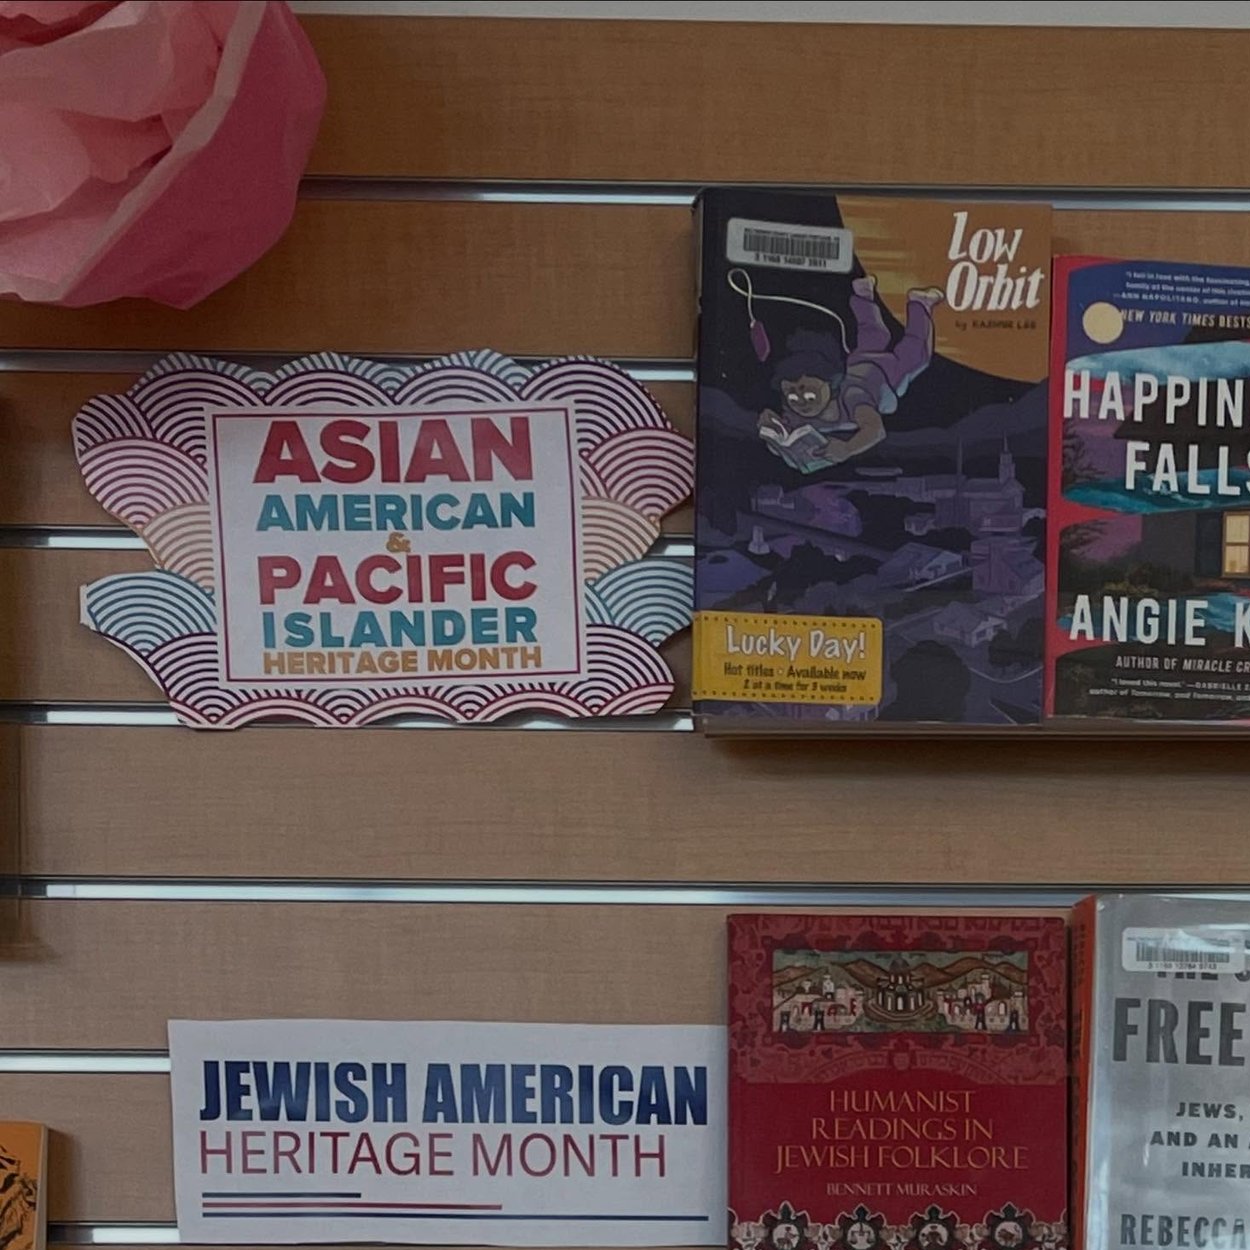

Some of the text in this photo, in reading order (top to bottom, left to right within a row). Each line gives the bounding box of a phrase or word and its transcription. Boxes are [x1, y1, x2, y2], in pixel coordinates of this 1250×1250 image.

[946, 261, 1045, 311] Orbit
[1121, 309, 1144, 322] NEW
[1149, 310, 1176, 324] YORK
[1182, 312, 1215, 327] TIMES
[253, 416, 532, 483] ASIAN
[256, 491, 534, 532] AMERICAN
[386, 532, 410, 552] &
[257, 550, 536, 605] PACIFIC
[263, 608, 536, 648] ISLANDER
[1069, 594, 1209, 646] ANGIE
[726, 624, 866, 663] Lucky Day!
[263, 647, 541, 675] HERITAGE MONTH
[787, 665, 839, 680] Available
[1115, 655, 1159, 670] AUTHOR
[1164, 658, 1178, 670] OF
[1182, 658, 1232, 673] MIRACLE
[1112, 997, 1246, 1067] FREE
[200, 1060, 709, 1126] JEWISH AMERICAN
[829, 1090, 976, 1113] HUMANIST
[812, 1117, 994, 1140] READINGS IN
[1176, 1102, 1244, 1122] JEWS,
[201, 1130, 667, 1178] HERITAGE MONTH
[1150, 1131, 1238, 1149] AND AN
[775, 1145, 1029, 1175] JEWISH FOLKLORE
[827, 1182, 977, 1197] BENNETT MURASKIN
[1120, 1213, 1246, 1249] REBECCA
